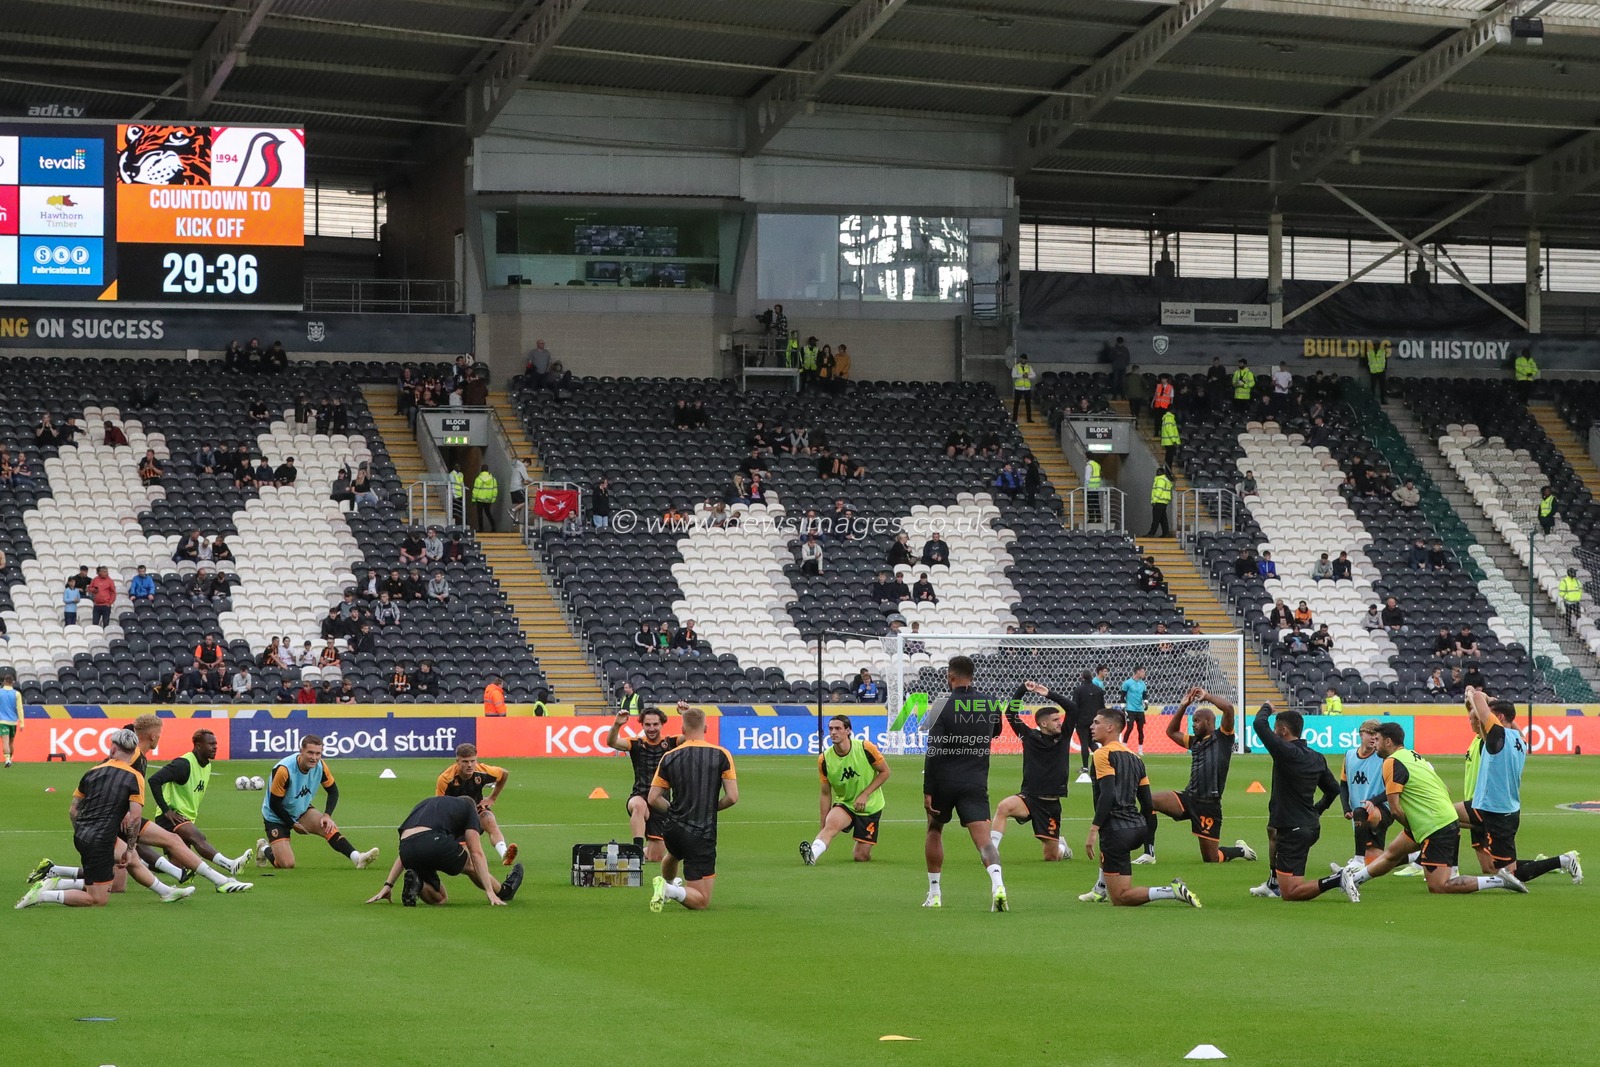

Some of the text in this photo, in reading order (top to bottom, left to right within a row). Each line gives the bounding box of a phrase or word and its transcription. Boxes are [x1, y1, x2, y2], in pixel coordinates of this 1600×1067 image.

[28, 104, 84, 118] adi.tv
[39, 155, 86, 170] tevalis
[215, 153, 238, 164] 1894
[150, 188, 271, 211] COUNTDOWN TO
[40, 211, 83, 220] Hawthorn
[46, 220, 77, 228] Timber
[176, 218, 245, 238] KICK OFF
[32, 266, 91, 275] Fabrications Ltd
[162, 252, 258, 294] 29:36
[36, 319, 65, 338] ON
[72, 319, 164, 340] SUCCESS
[1398, 339, 1425, 359] ON
[1431, 340, 1510, 360] HISTORY
[250, 727, 457, 757] Hell good stuff
[738, 726, 803, 750] Hello
[866, 822, 875, 834] 4
[1200, 815, 1214, 830] 19
